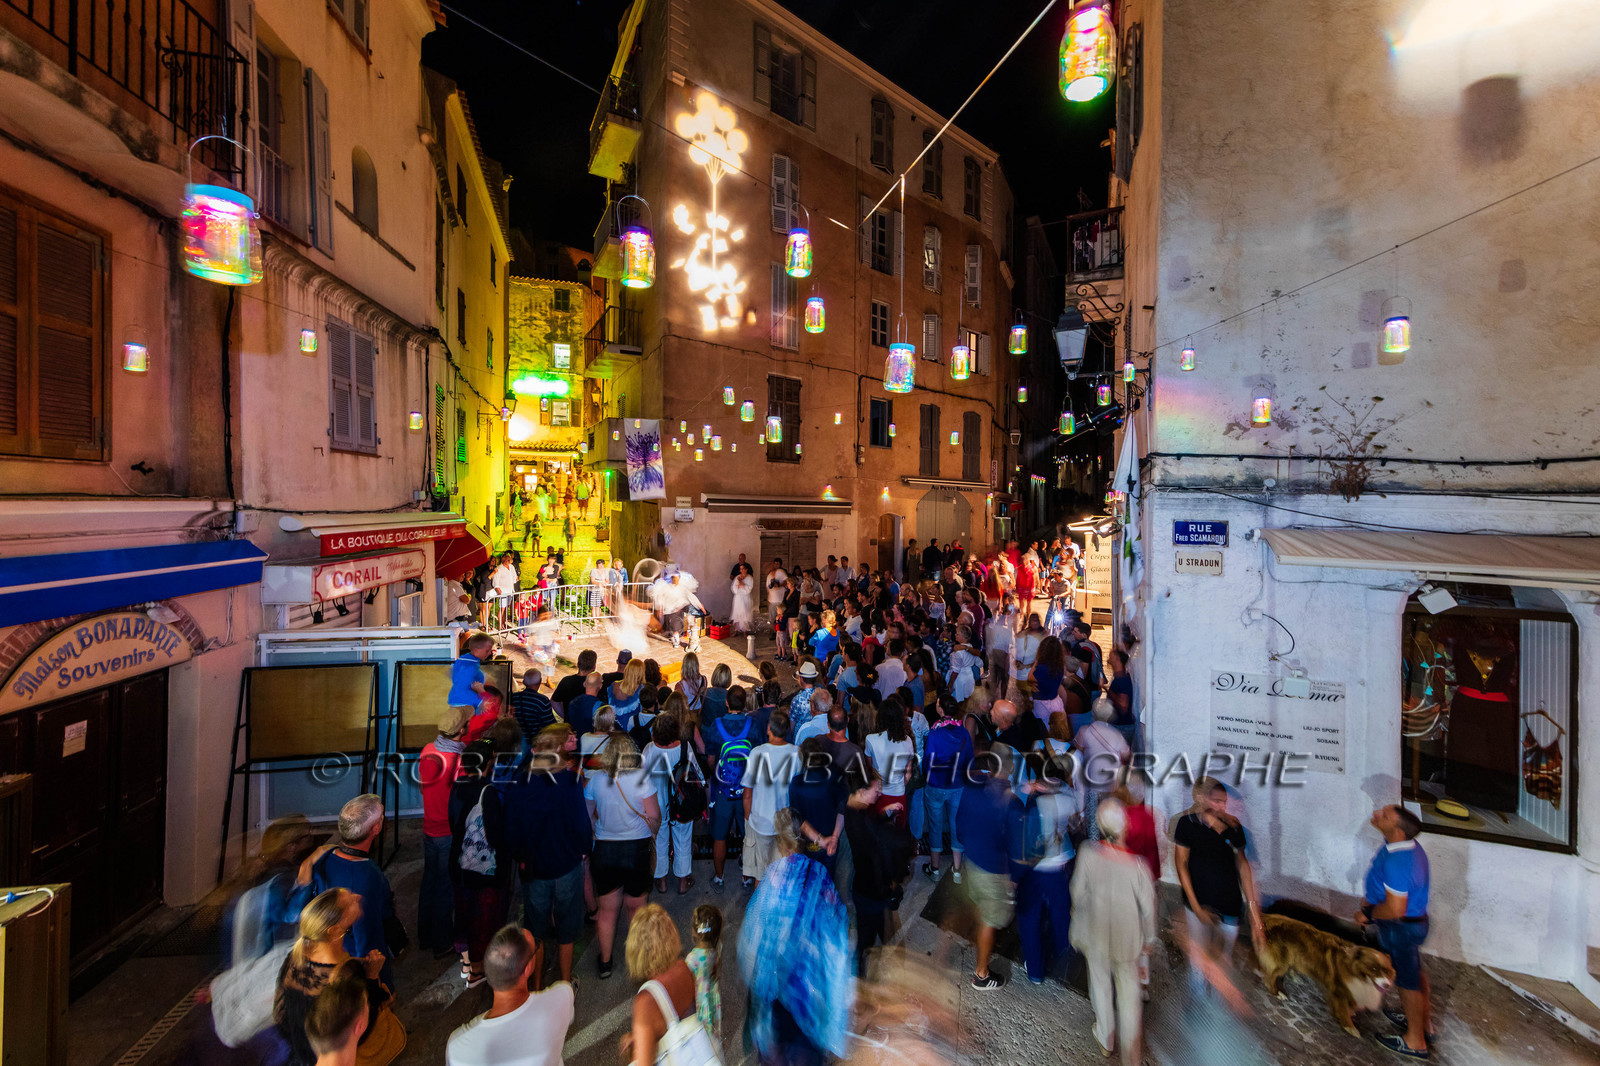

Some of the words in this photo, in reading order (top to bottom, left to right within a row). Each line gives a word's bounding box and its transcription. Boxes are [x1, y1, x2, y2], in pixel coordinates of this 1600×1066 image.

[330, 538, 346, 550] LA
[347, 532, 394, 549] BOUTIQUE
[394, 530, 408, 543] DU
[1188, 524, 1213, 533] RUE
[1178, 558, 1183, 566] U
[1185, 558, 1220, 568] STRADUN
[332, 566, 382, 589] CORAIL
[13, 641, 81, 700] Maison
[75, 617, 182, 658] BONAPARTE
[57, 648, 156, 689] Souvenirs
[1215, 672, 1260, 695] Via
